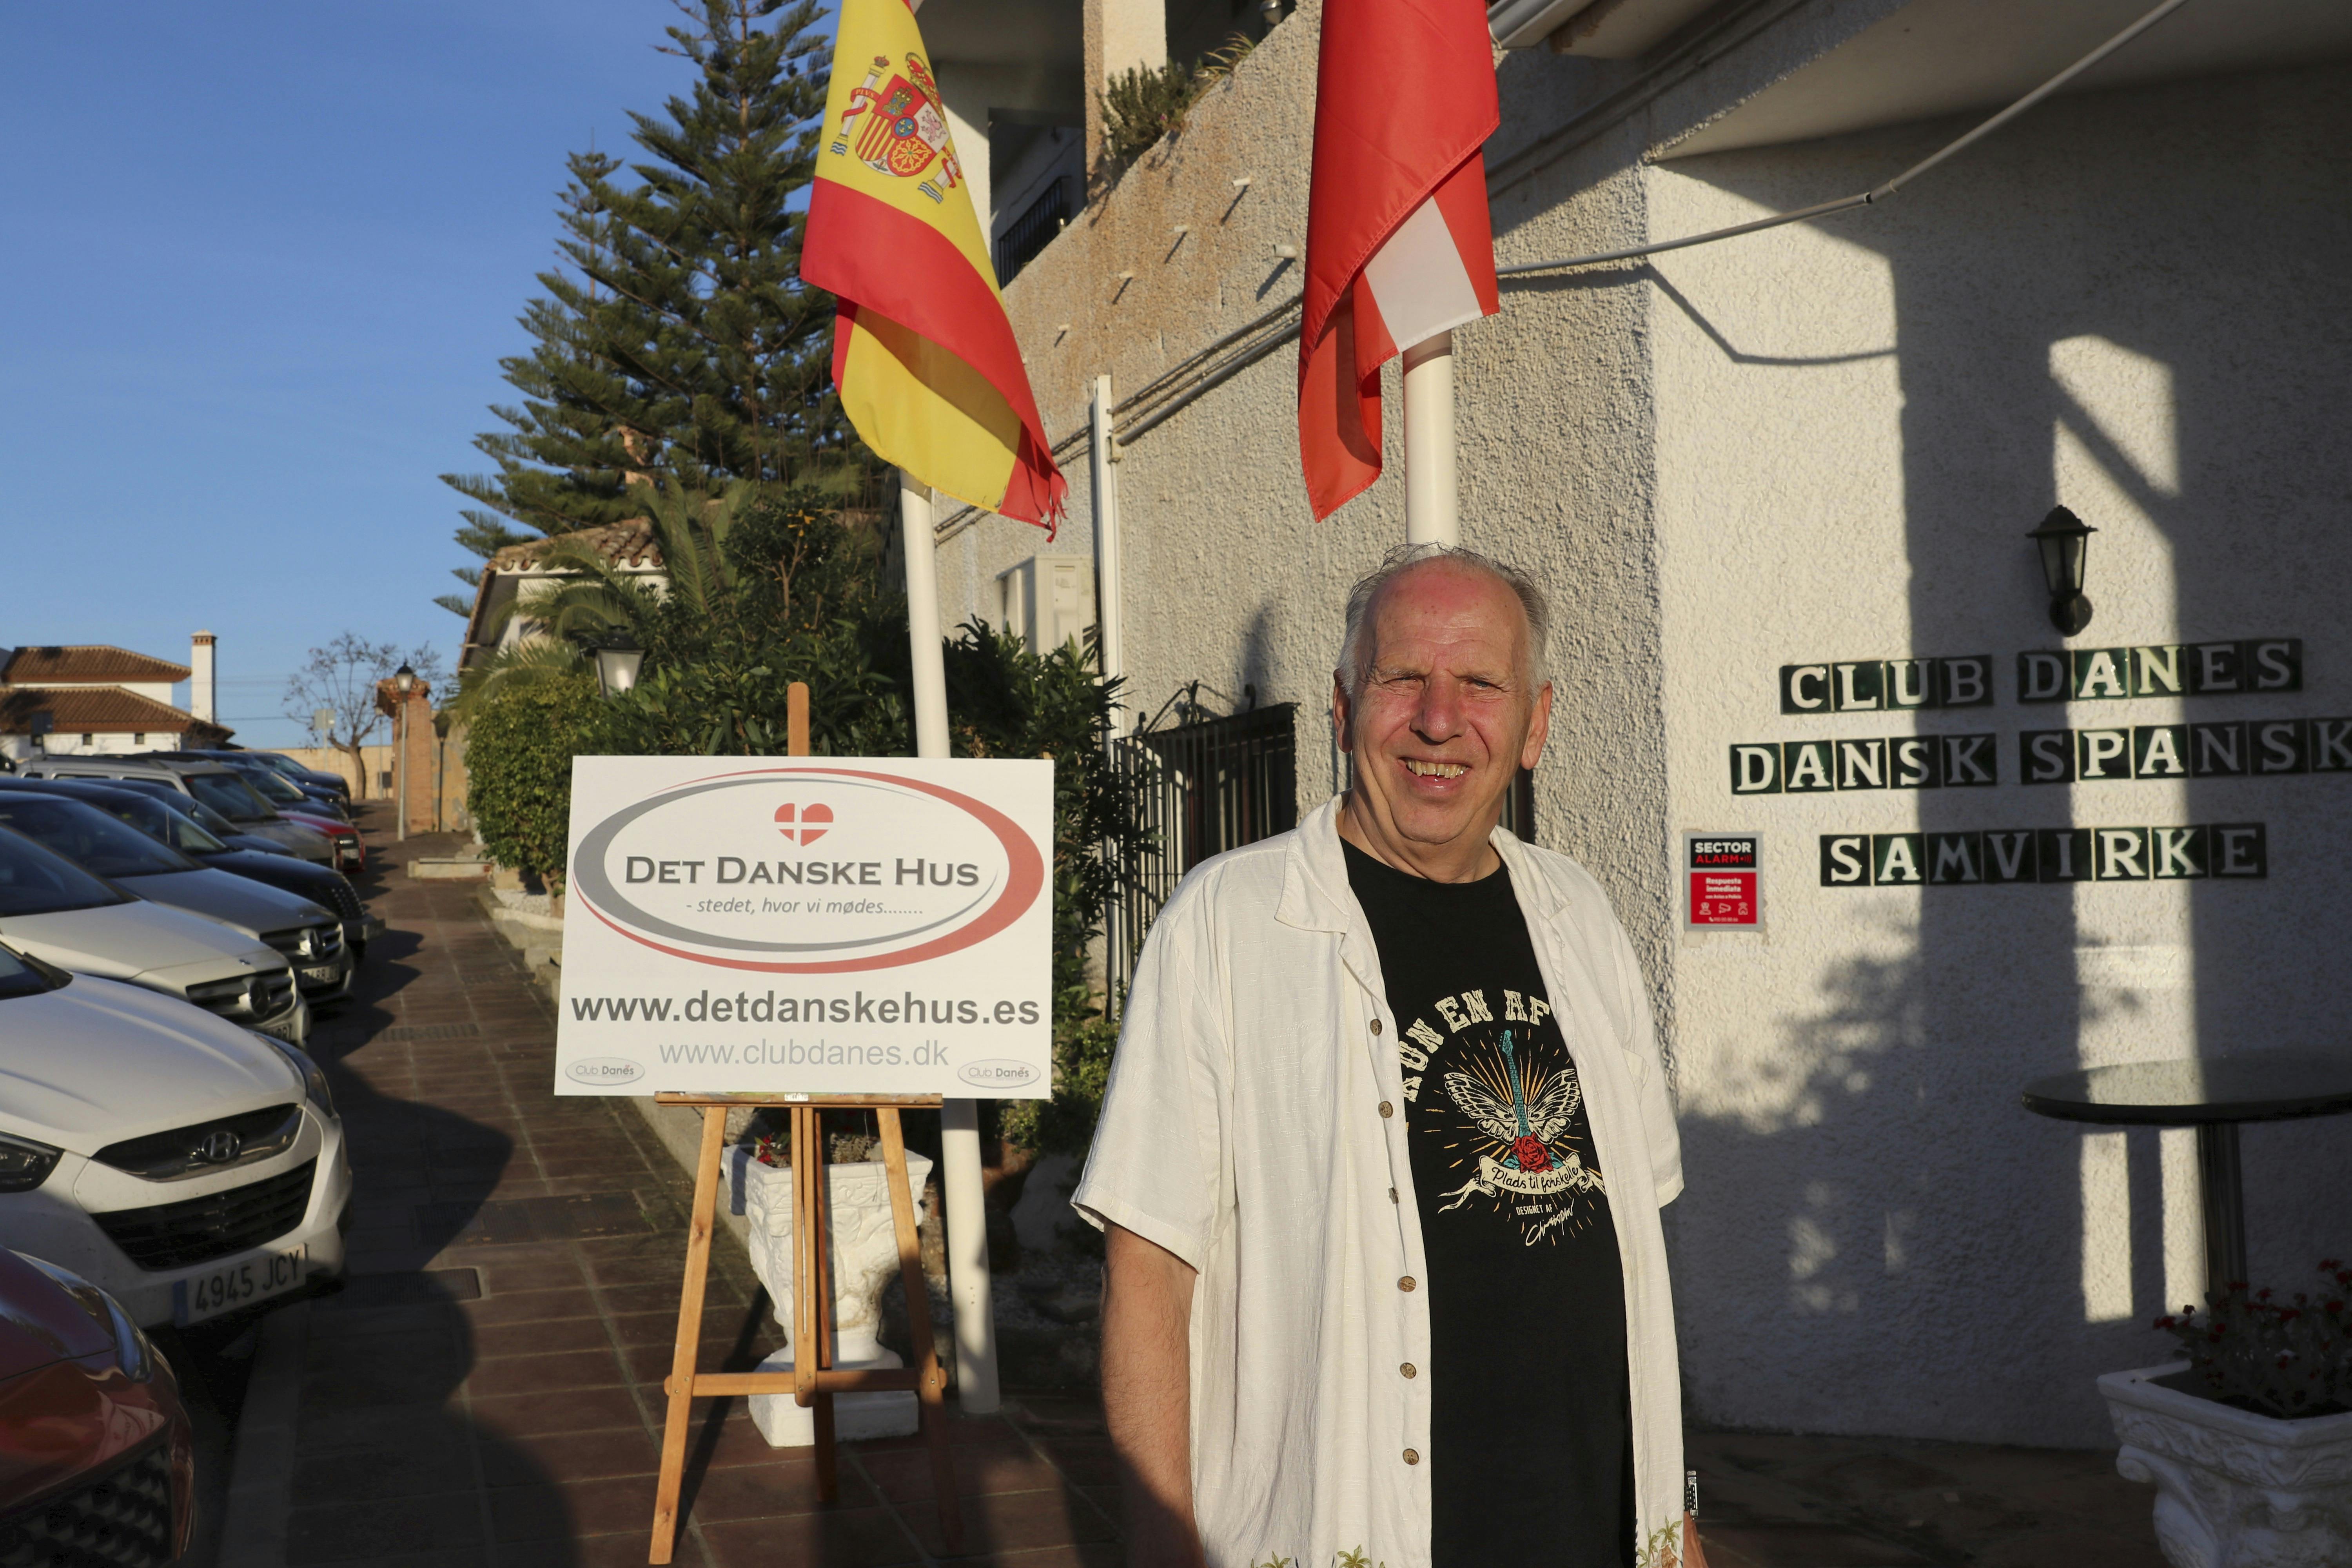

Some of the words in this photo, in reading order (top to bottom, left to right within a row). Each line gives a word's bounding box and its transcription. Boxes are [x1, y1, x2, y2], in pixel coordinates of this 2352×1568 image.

[1790, 659, 1985, 710] CLUB
[2023, 642, 2291, 699] DANES
[1736, 737, 1992, 791] DANSK
[2031, 720, 2352, 780] SPANSK
[1695, 842, 1751, 853] SECTOR
[1695, 854, 1739, 864] ALARM
[1830, 828, 2257, 883] SAMVIRKE
[1706, 877, 1742, 886] Respuesta
[697, 897, 755, 915] stedet,
[762, 897, 800, 913] hvor
[806, 898, 821, 913] vi
[571, 989, 1040, 1025] www.detdanskehus.es
[1434, 989, 1494, 1034] EN
[1503, 989, 1550, 1026] AF
[659, 1038, 949, 1066] www.clubdanes.dk
[575, 1065, 599, 1075] Club
[968, 1067, 992, 1077] Club
[1492, 1167, 1526, 1189] Plads
[1528, 1175, 1539, 1189] til
[1541, 1165, 1579, 1193] forskelle
[1515, 1204, 1543, 1216] DESIGNET
[1545, 1203, 1553, 1213] AF
[195, 1265, 254, 1312] 4945
[262, 1249, 299, 1290] JCY
